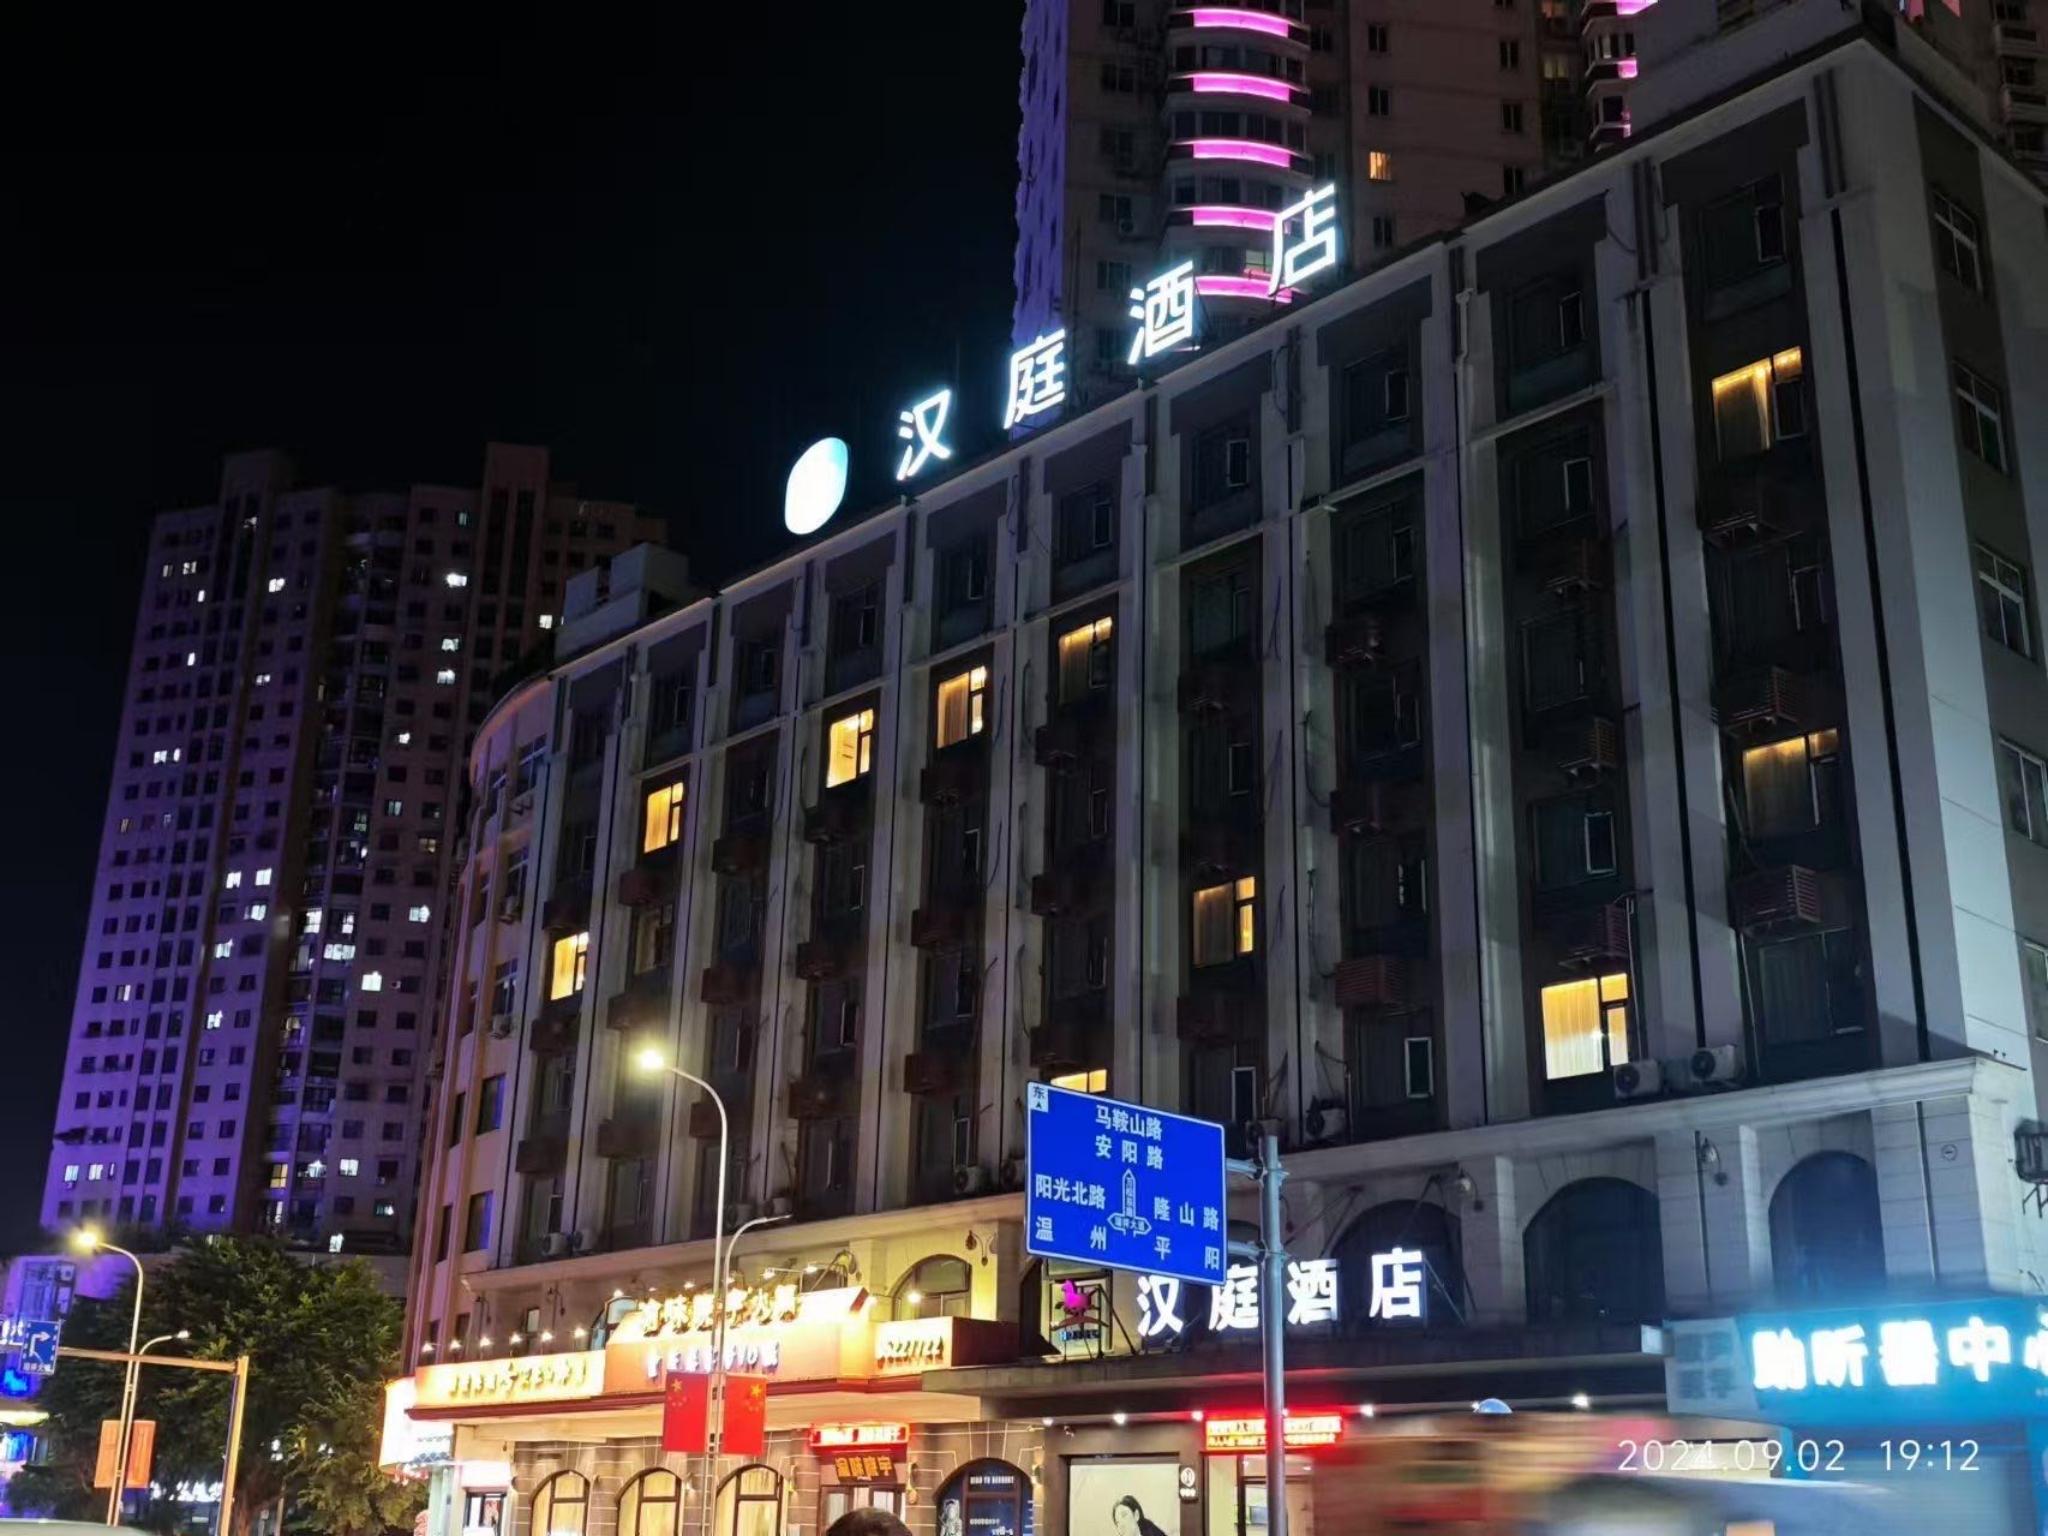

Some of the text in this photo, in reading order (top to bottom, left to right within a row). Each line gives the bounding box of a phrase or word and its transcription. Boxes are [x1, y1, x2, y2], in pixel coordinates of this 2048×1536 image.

[895, 183, 1337, 481] 汉庭酒店
[1033, 1086, 1045, 1099] 东
[1095, 1104, 1163, 1140] 马鞍山路
[1095, 1135, 1163, 1169] 安阳路
[1034, 1174, 1106, 1210] 阳光北路
[1153, 1197, 1219, 1231] 隆山路
[1034, 1216, 1107, 1251] 温州
[1153, 1236, 1220, 1270] 平阳
[1136, 1246, 1424, 1337] 汉庭酒店
